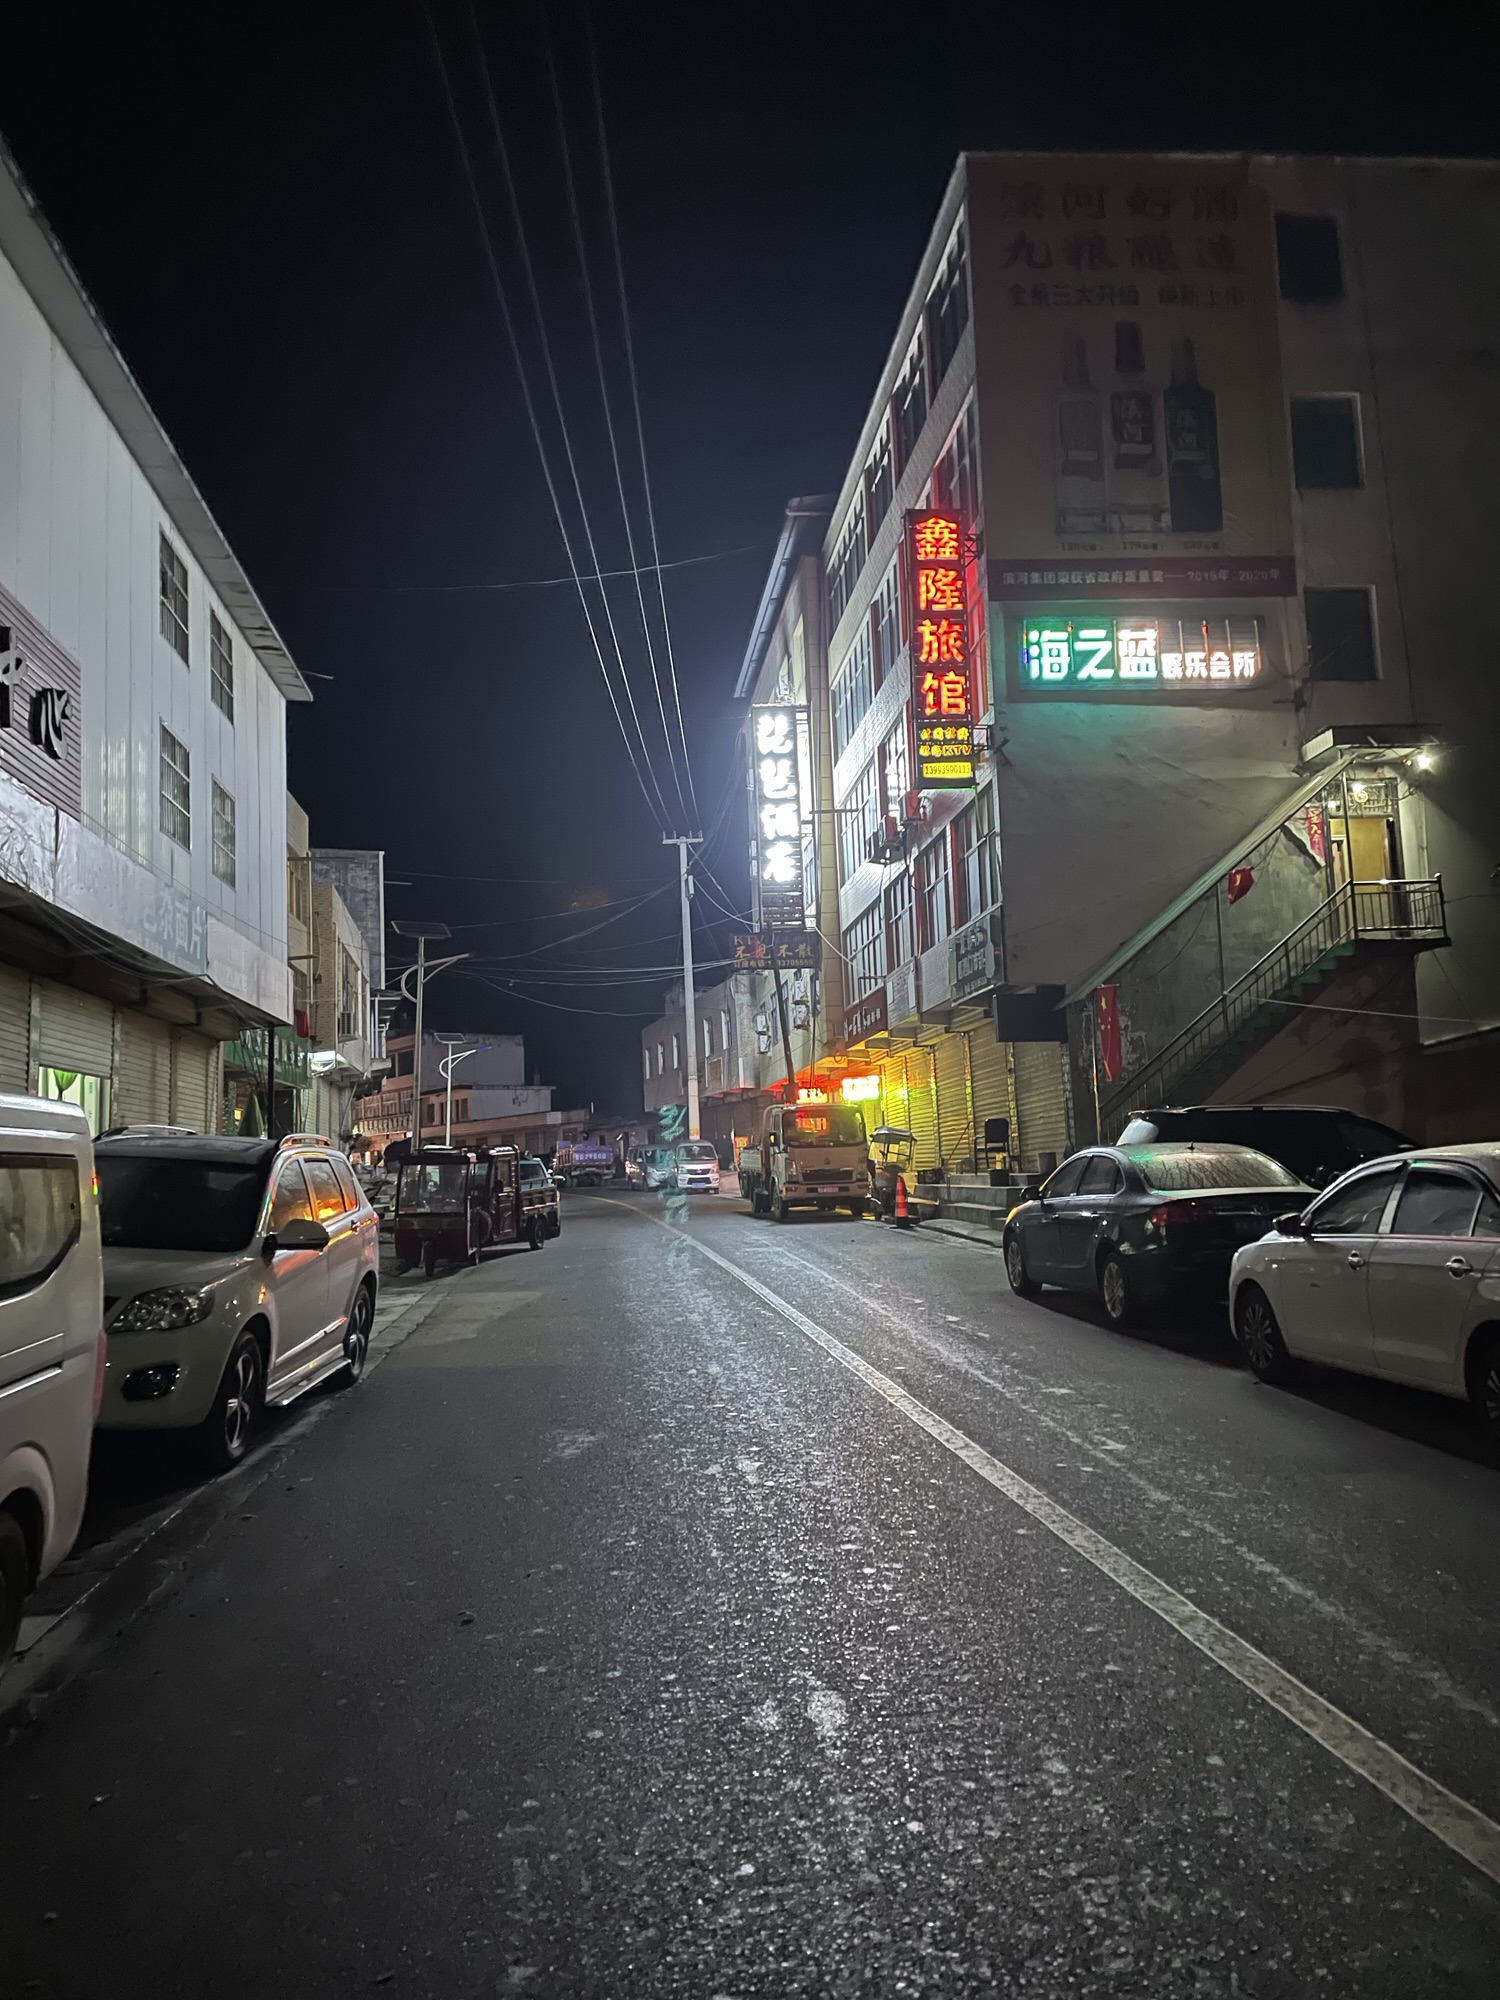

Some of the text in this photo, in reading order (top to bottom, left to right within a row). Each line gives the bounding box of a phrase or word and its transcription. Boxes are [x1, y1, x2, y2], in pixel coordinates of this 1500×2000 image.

[915, 516, 967, 716] 鑫隆旅馆
[1029, 629, 1257, 680] 海之蓝 娱乐会所
